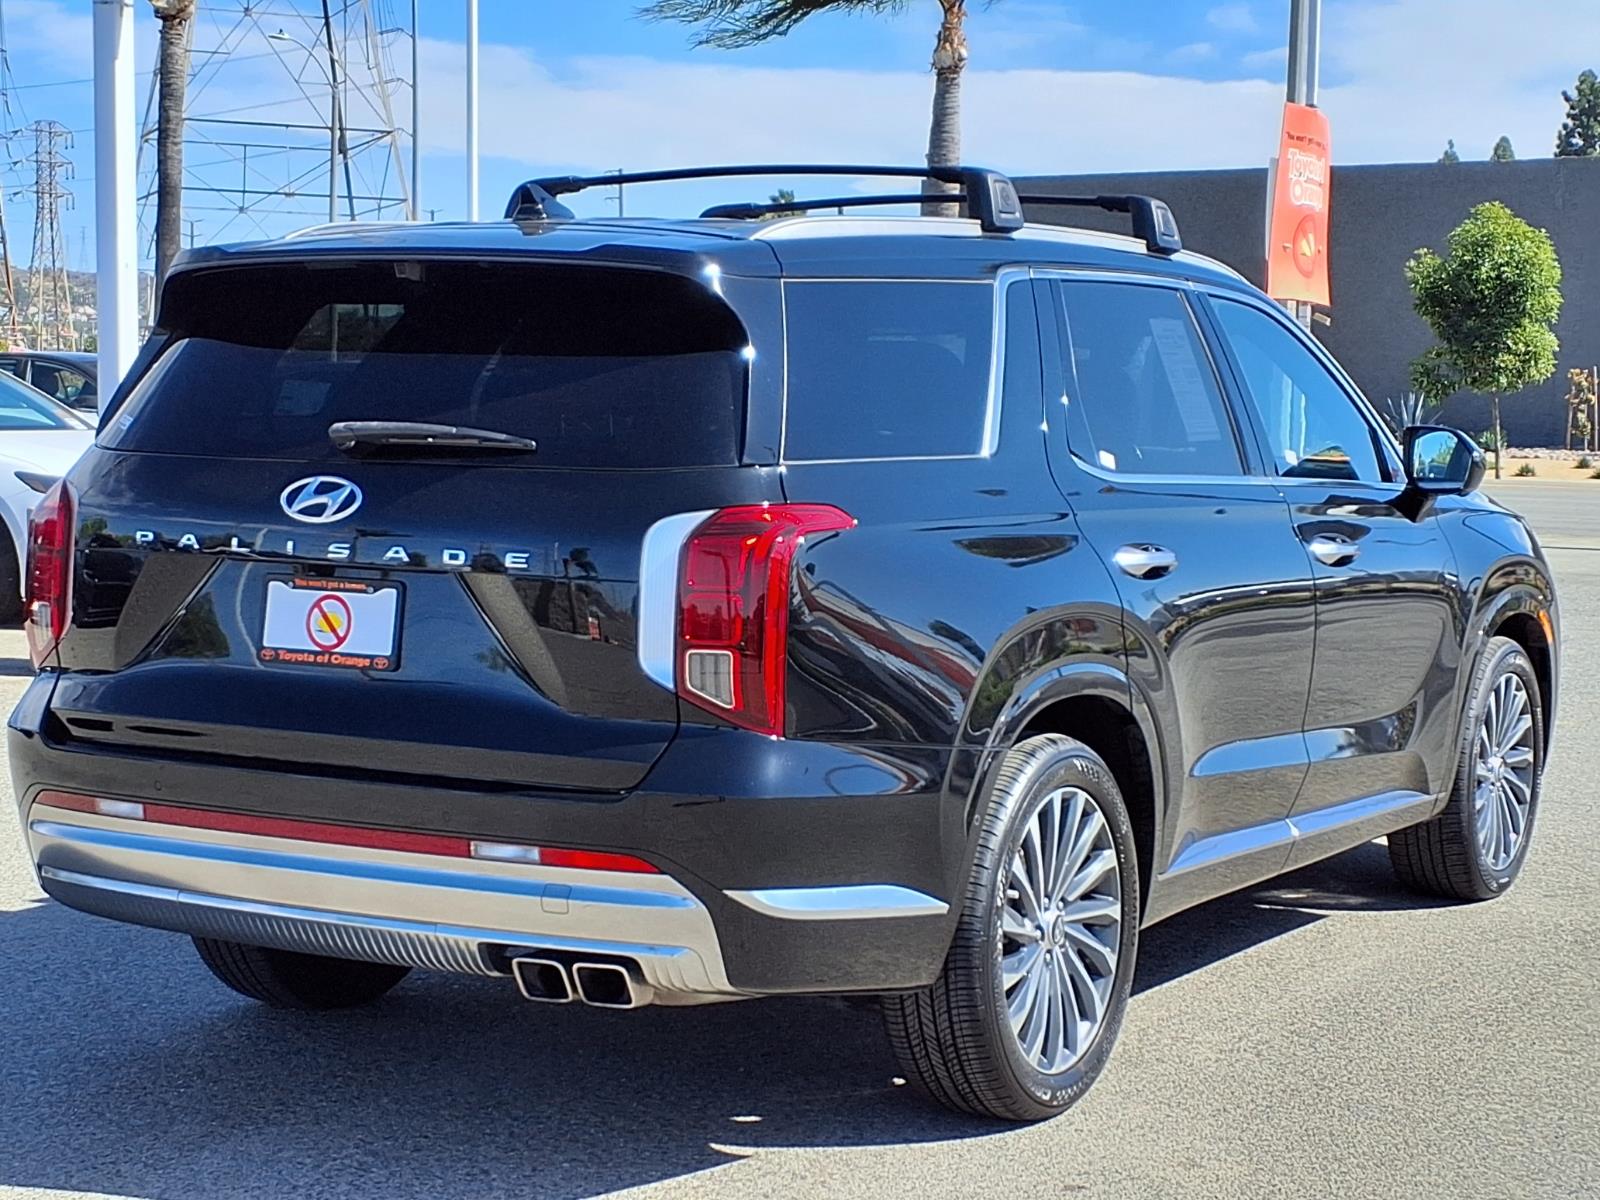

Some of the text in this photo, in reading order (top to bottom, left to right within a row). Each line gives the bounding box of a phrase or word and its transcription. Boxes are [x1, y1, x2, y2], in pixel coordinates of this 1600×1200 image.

[135, 530, 531, 569] PALISADE
[277, 650, 371, 667] Toyota of Orange
